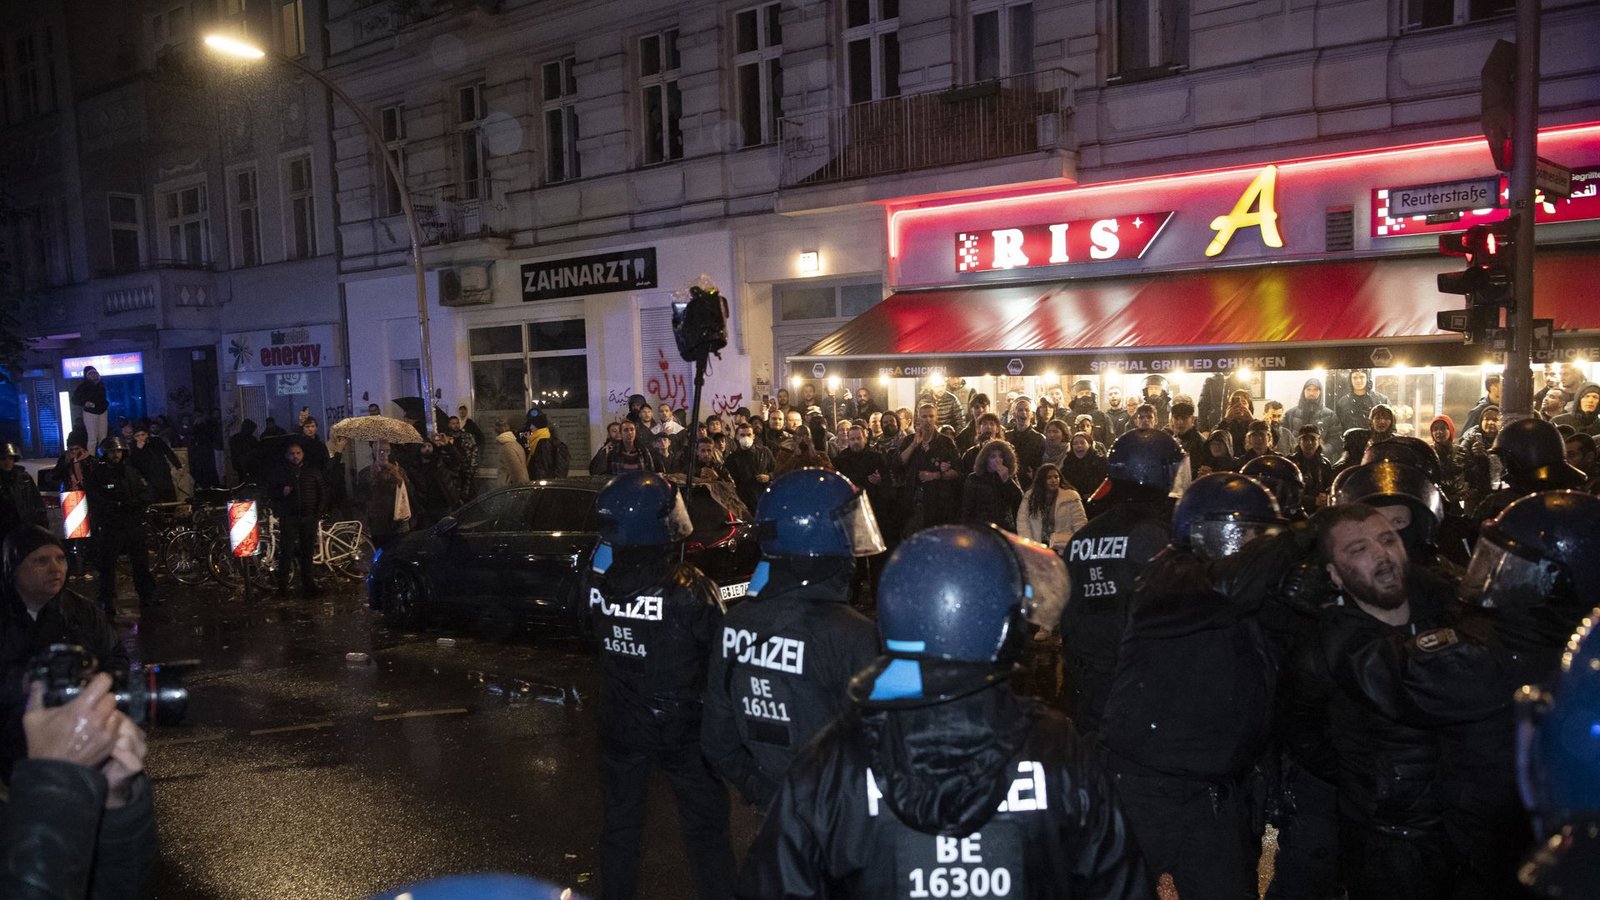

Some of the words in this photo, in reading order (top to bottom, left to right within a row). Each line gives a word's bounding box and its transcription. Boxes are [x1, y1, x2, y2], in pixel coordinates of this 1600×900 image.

[1401, 185, 1488, 208] Reuterstraße
[992, 218, 1120, 269] RIS
[1205, 164, 1284, 257] A
[524, 259, 631, 293] ZAHNARZT
[260, 344, 322, 368] energy
[1090, 360, 1147, 372] SPECIAL
[1151, 358, 1213, 371] GRILLED
[1217, 356, 1286, 370] CHICKEN
[1536, 347, 1600, 361] CHICKE
[1069, 536, 1128, 561] POLIZEI
[1089, 566, 1104, 581] BE
[1083, 580, 1117, 598] 22313
[612, 625, 634, 641] BE
[603, 637, 648, 658] 16114
[722, 626, 805, 675] POLIZEI
[750, 676, 773, 698] BE
[742, 696, 791, 722] 16111
[936, 832, 983, 864] BE
[908, 867, 1011, 898] 16300
